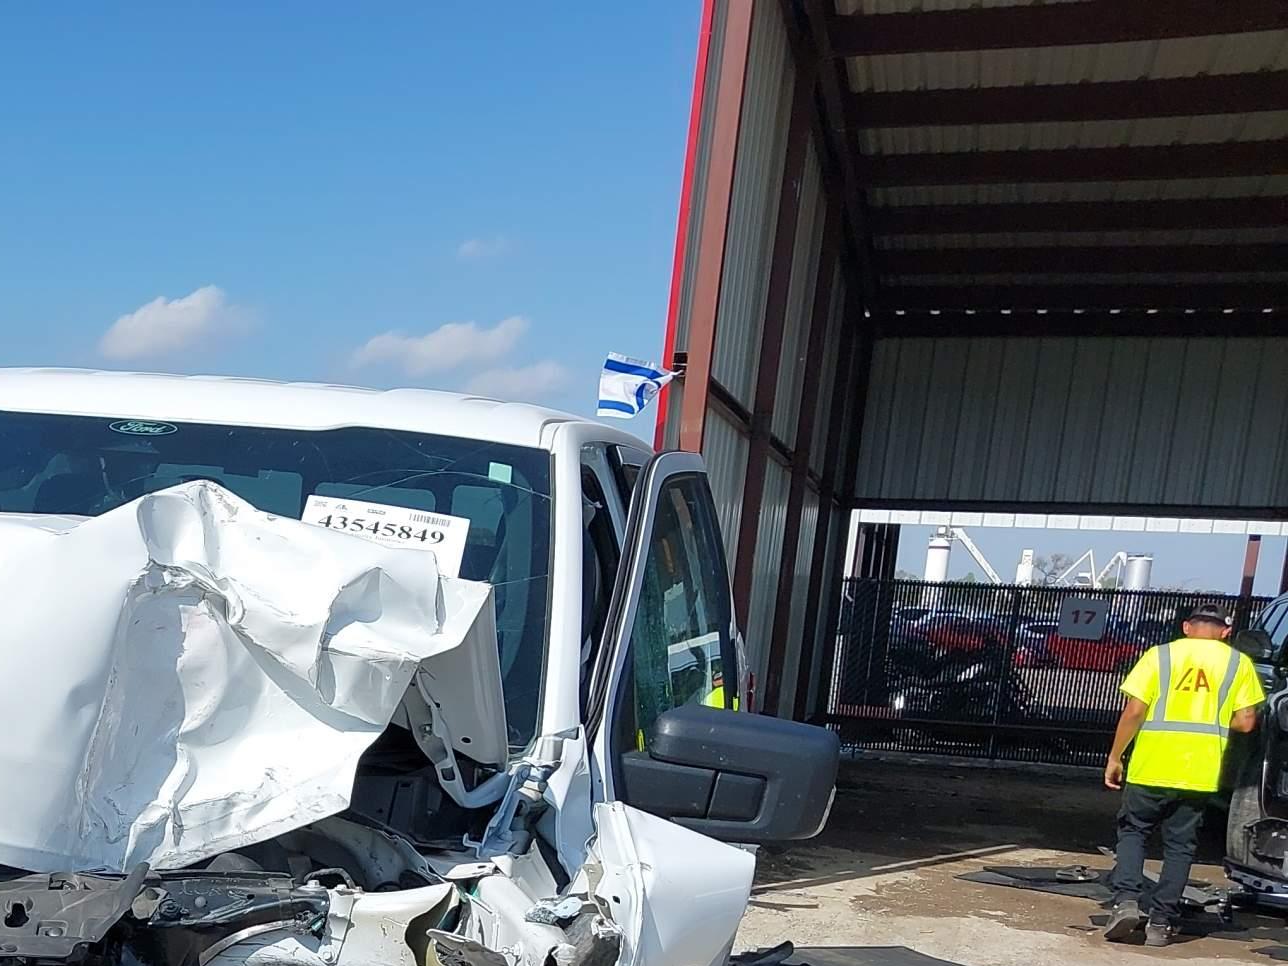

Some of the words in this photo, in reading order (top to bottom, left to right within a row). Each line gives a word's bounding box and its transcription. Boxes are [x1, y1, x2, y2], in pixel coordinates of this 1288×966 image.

[119, 421, 167, 433] Ford
[318, 514, 445, 545] 43545849
[1072, 609, 1097, 625] 17
